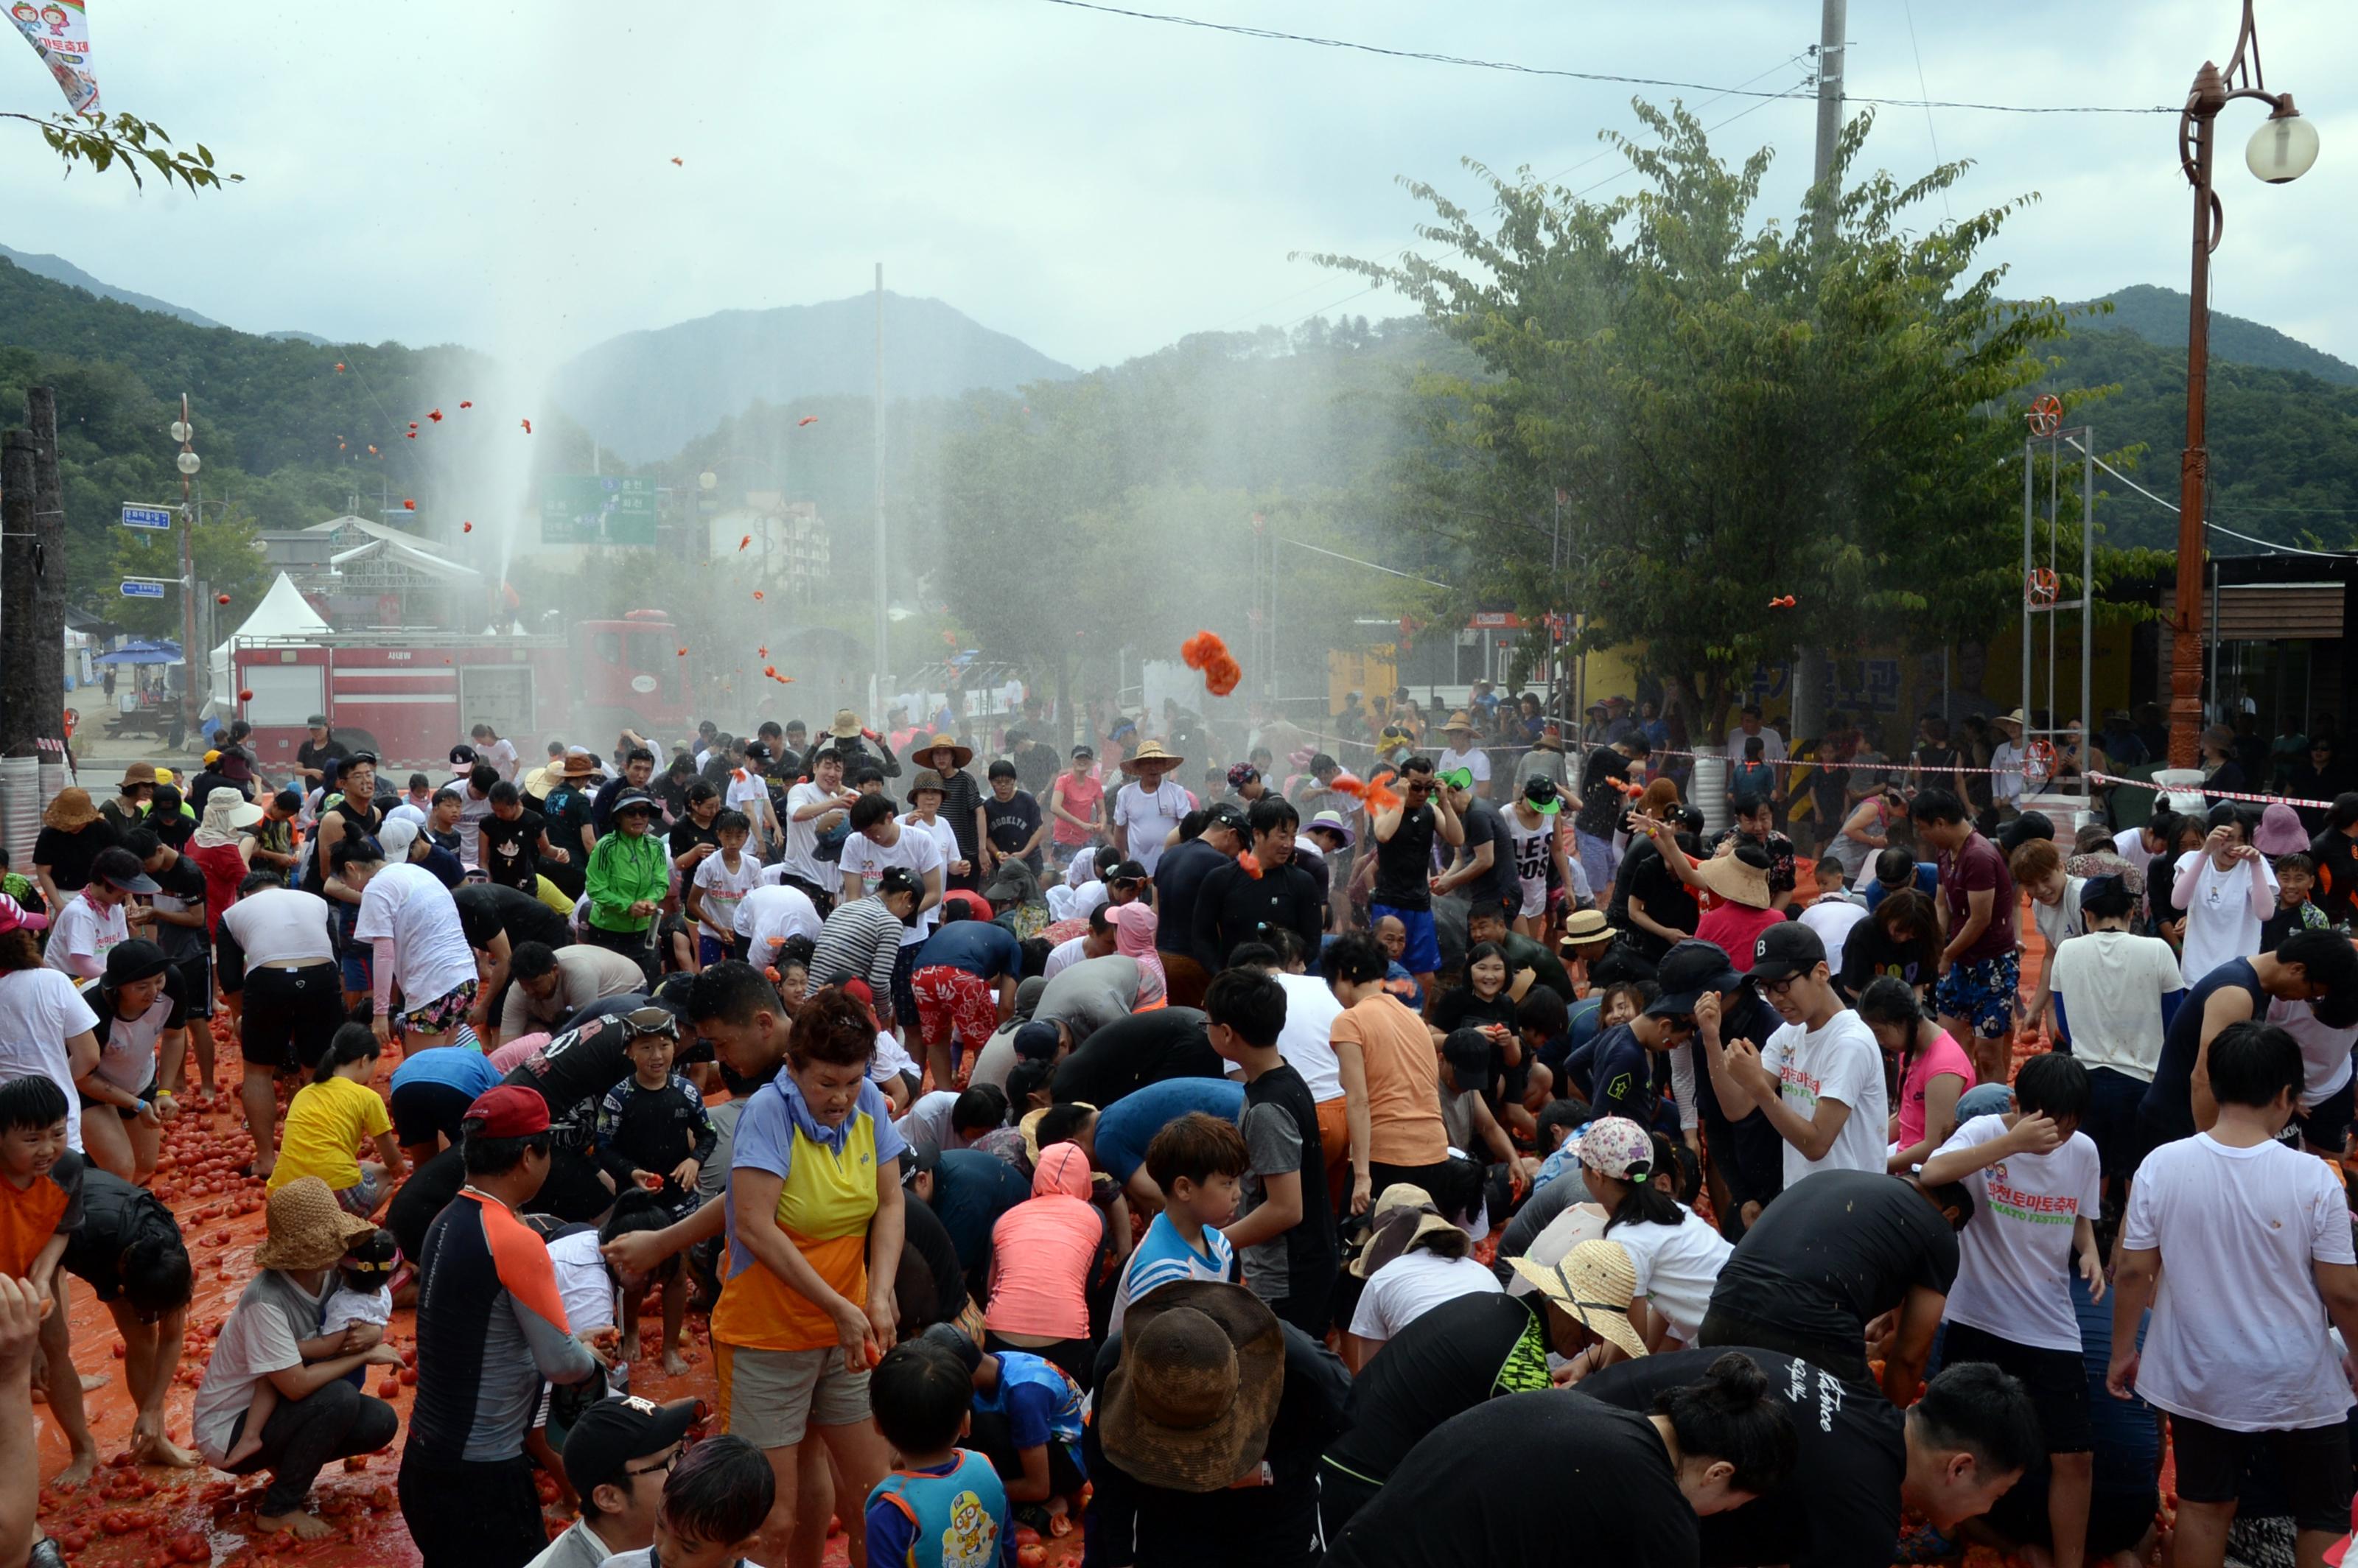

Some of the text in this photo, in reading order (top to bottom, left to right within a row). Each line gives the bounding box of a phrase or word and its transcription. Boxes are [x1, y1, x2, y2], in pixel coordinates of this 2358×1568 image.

[990, 816, 1027, 831] ROOKLYN
[1757, 939, 1766, 956] B
[424, 1222, 448, 1308] new balance
